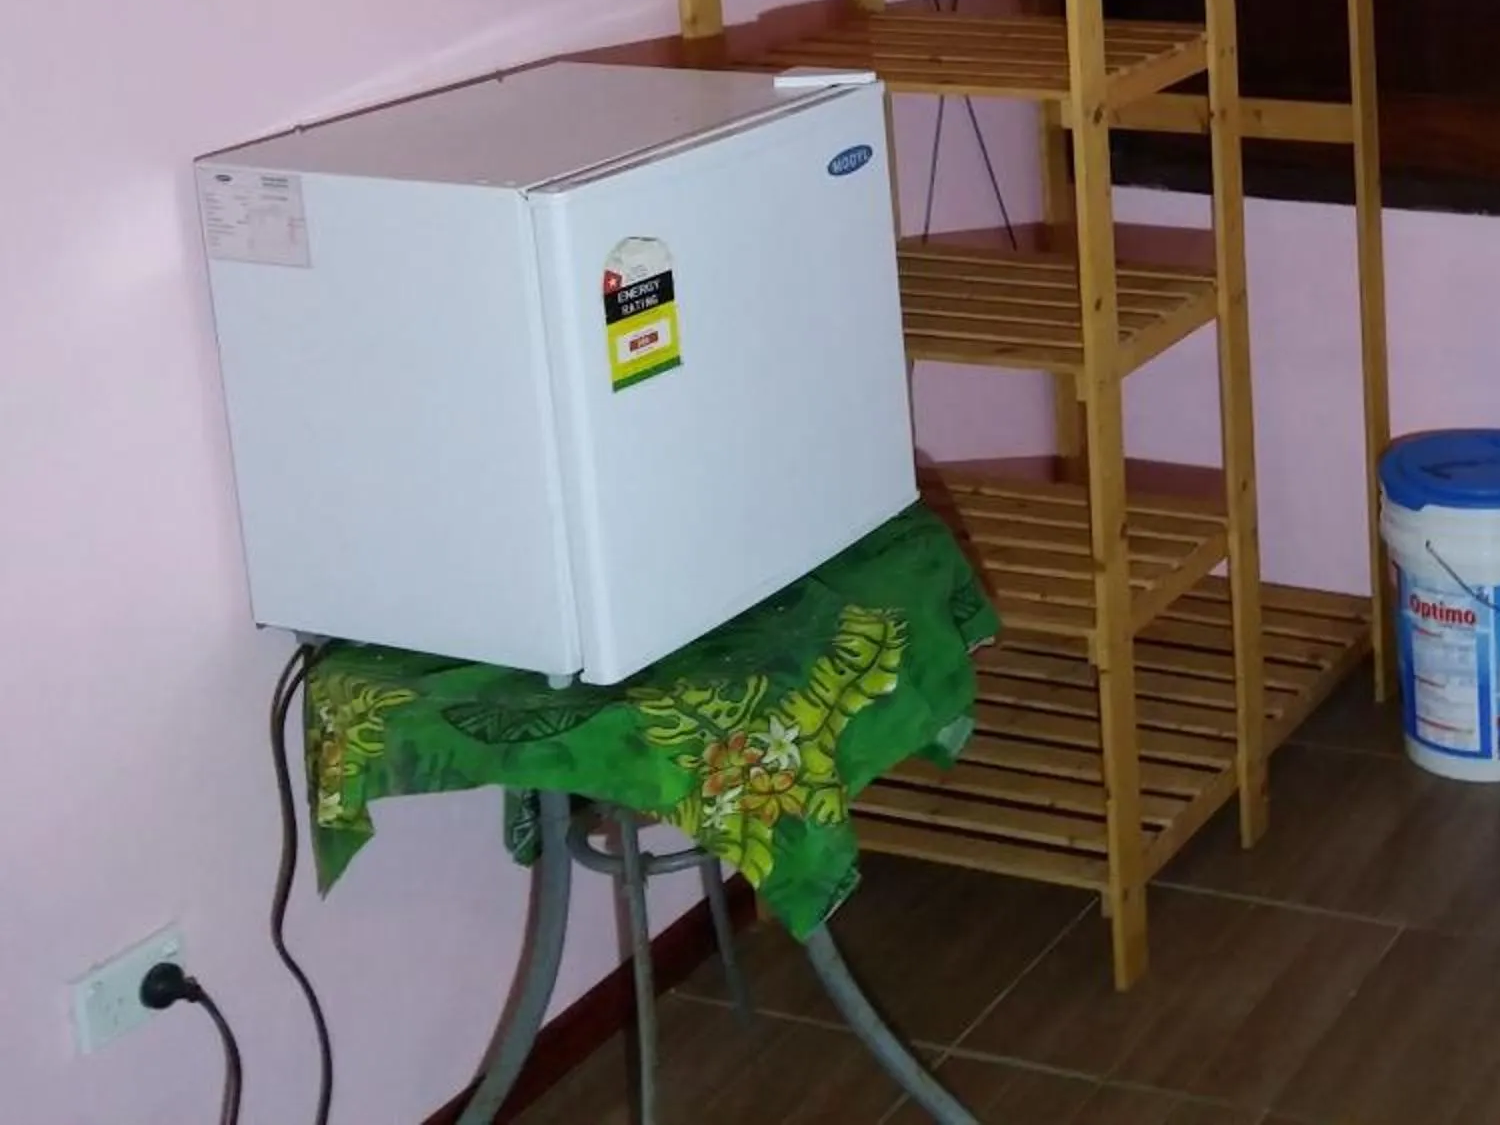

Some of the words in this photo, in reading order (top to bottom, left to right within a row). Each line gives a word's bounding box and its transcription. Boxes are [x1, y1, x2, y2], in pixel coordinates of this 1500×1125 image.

[617, 278, 660, 304] ENERGY
[621, 294, 660, 316] RATING
[1409, 593, 1477, 626] Optimo
